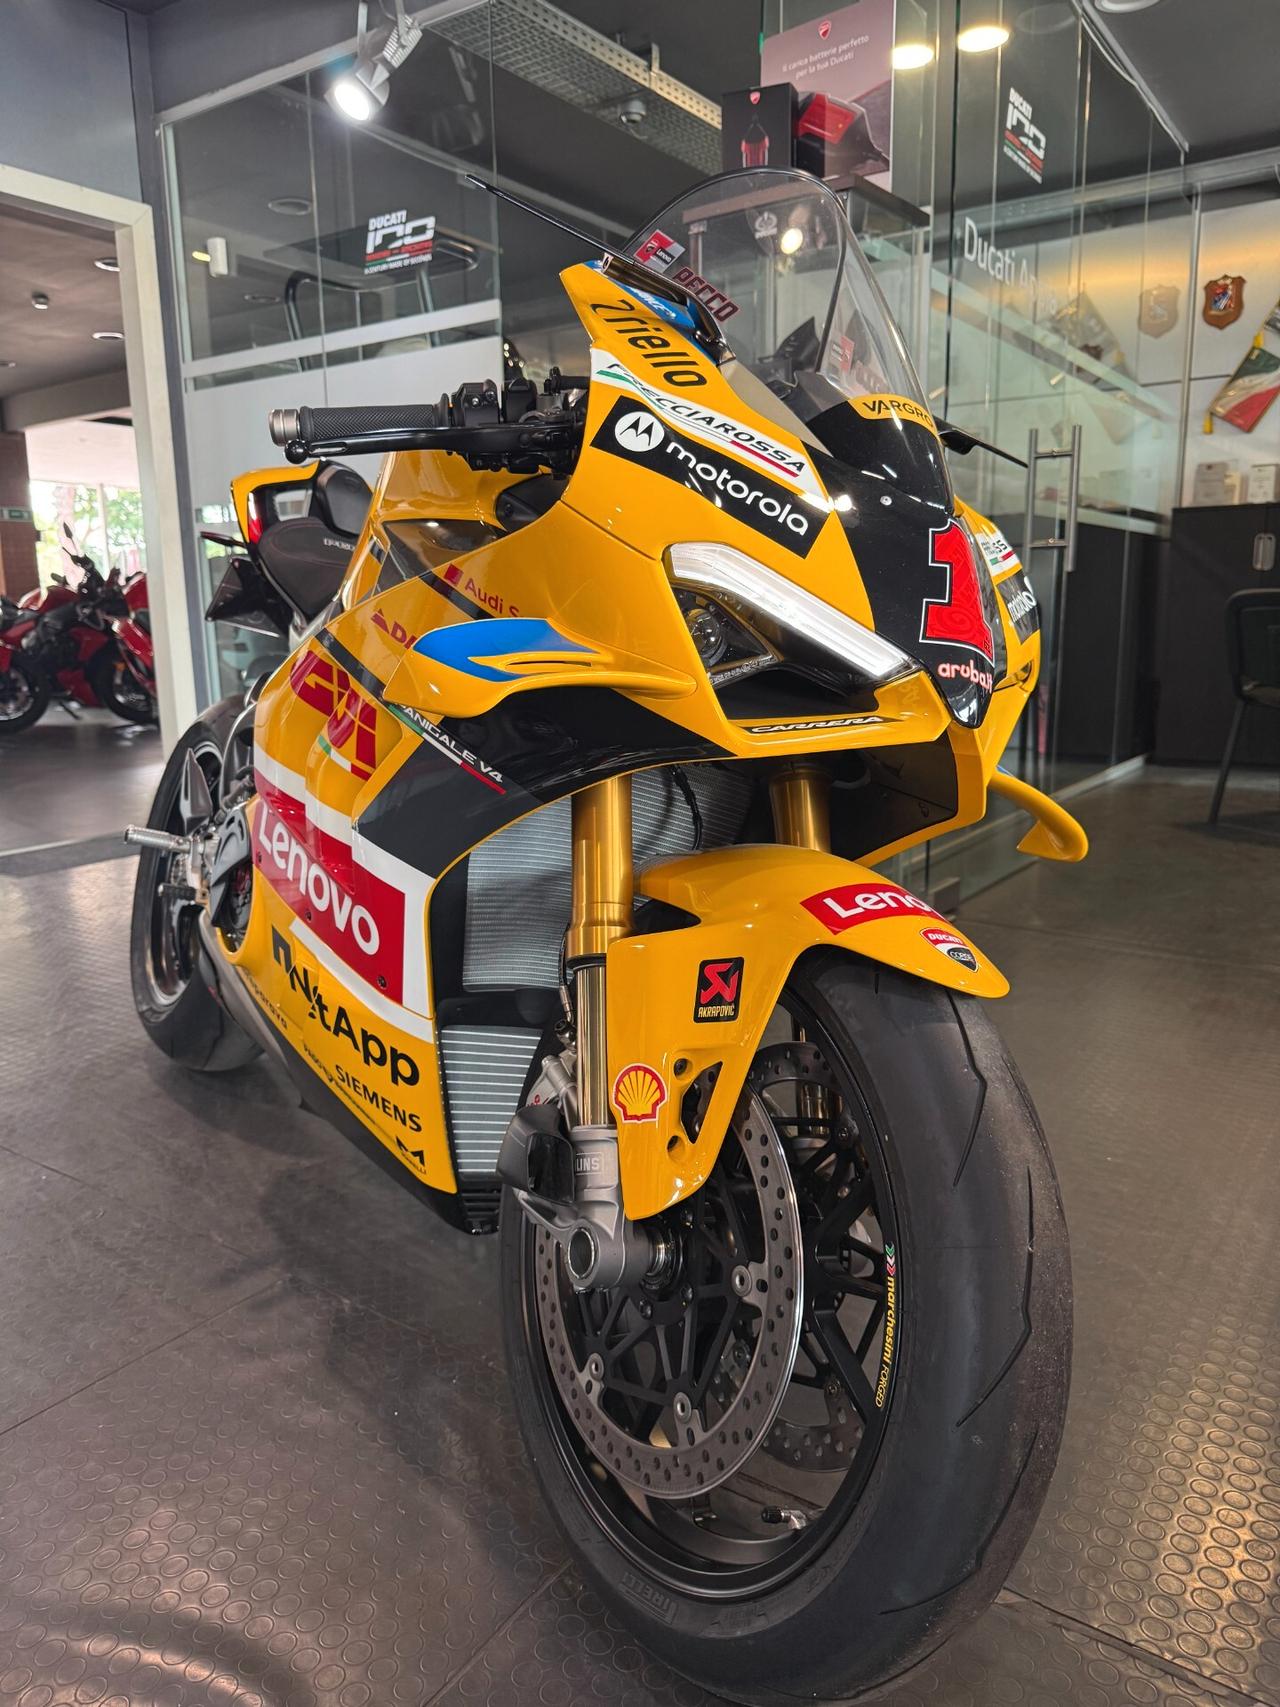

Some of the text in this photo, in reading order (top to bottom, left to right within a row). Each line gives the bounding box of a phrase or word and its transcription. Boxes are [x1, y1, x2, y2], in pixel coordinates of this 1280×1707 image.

[795, 68, 808, 80] per
[816, 60, 829, 72] tua
[830, 51, 855, 66] Ducati
[809, 46, 837, 63] batterie
[838, 35, 870, 53] perfetto
[1009, 87, 1033, 121] DUCATI
[368, 209, 407, 232] DUCATI
[656, 248, 672, 263] Lenovo
[964, 215, 1016, 288] Ducati
[672, 265, 740, 323] PECCO
[861, 398, 935, 429] VARGRO
[665, 440, 809, 537] motorola
[465, 577, 504, 615] Audi
[751, 715, 884, 734] CARRERA
[396, 703, 504, 784] ANIGALE V4
[258, 801, 381, 956] Lenovo
[822, 890, 940, 920] Leno
[927, 932, 964, 945] DUCATI
[335, 1064, 423, 1133] SIEMENS
[875, 1275, 897, 1408] marchesini FORGED
